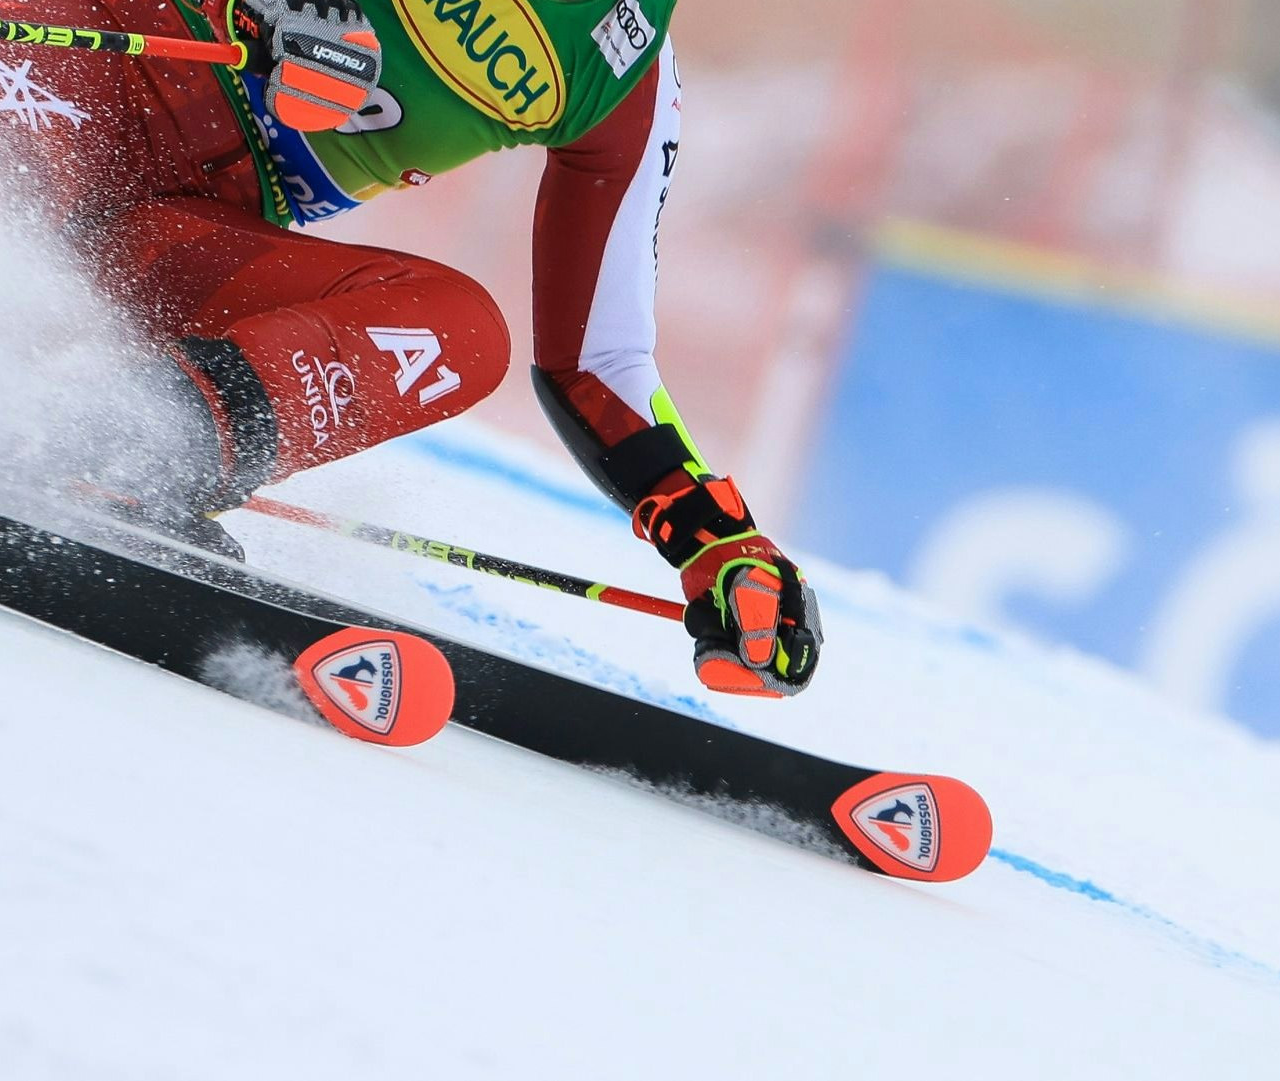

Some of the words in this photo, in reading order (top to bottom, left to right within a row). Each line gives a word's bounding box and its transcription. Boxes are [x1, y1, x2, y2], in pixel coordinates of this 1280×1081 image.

[312, 45, 367, 71] reusch
[292, 350, 331, 449] UNIQA
[366, 327, 461, 407] A1
[375, 652, 395, 721] ROSSIGNOL
[915, 794, 932, 860] ROSSIGNOL
